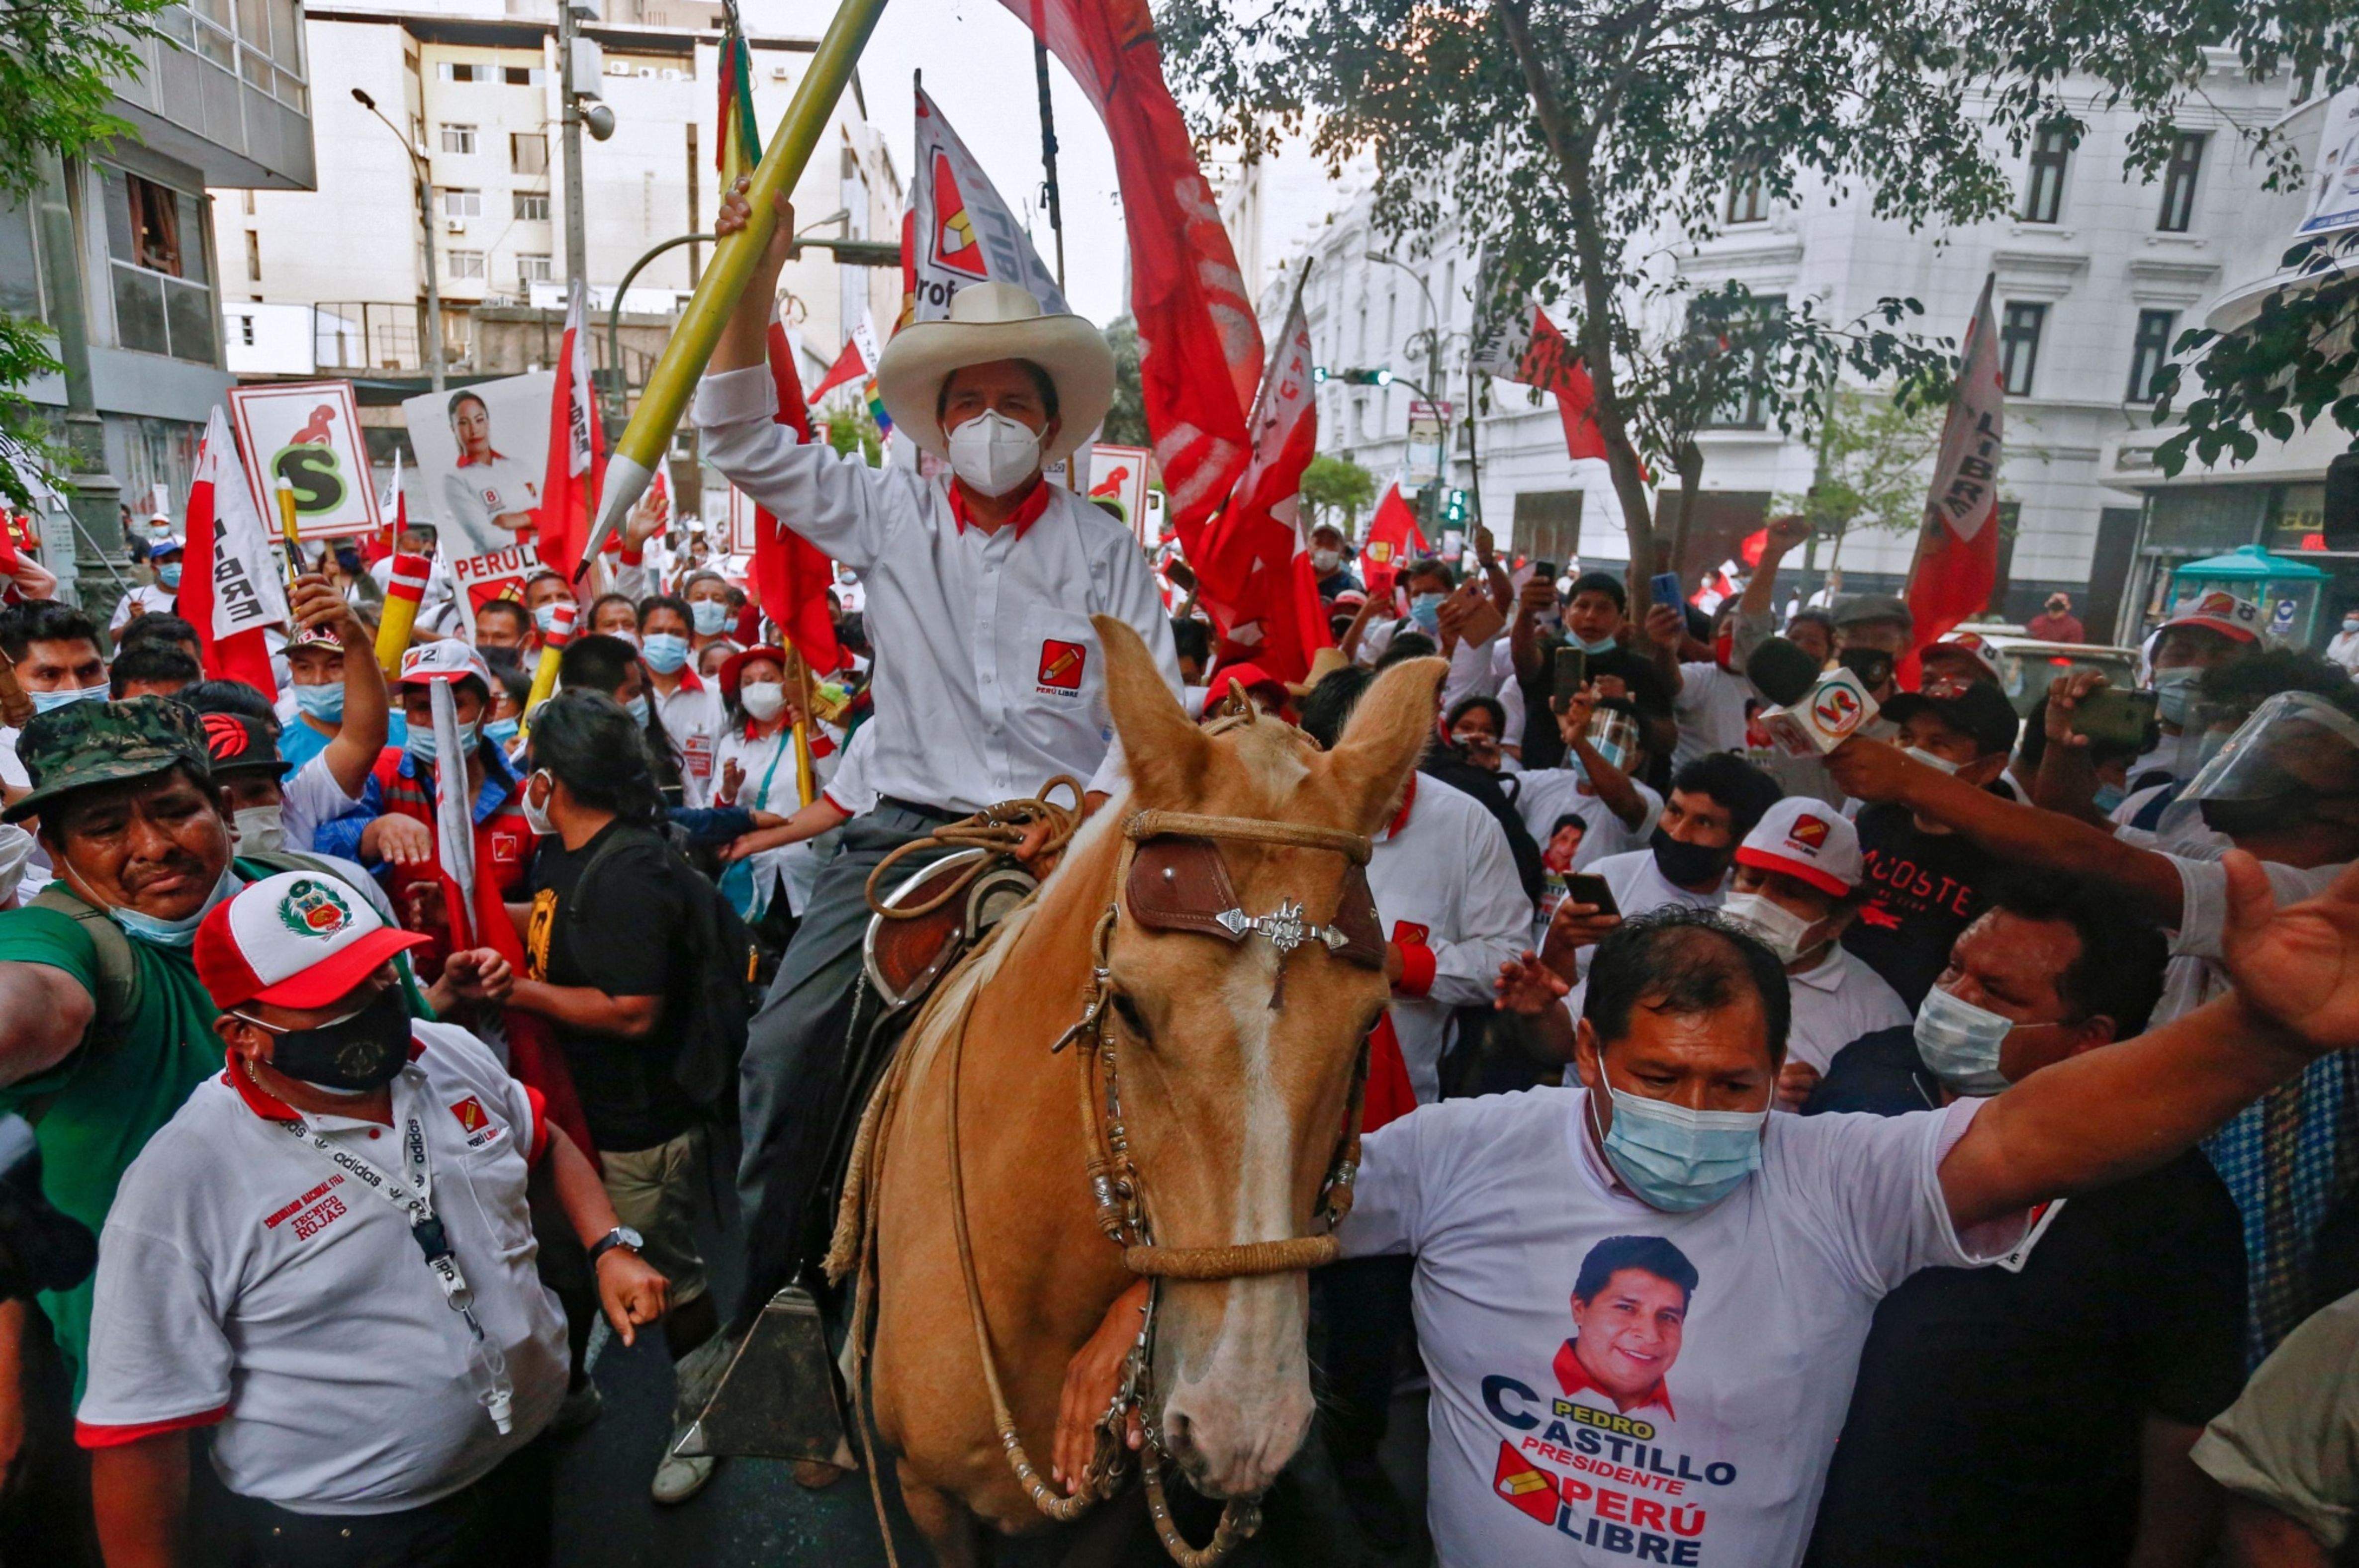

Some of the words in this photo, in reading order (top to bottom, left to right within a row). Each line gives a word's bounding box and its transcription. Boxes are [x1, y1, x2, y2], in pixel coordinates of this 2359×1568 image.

[486, 490, 496, 502] 8
[2238, 602, 2256, 621] 8
[422, 650, 437, 661] 2
[1058, 689, 1079, 698] LIBRE
[408, 1119, 425, 1164] adidas
[334, 1152, 381, 1187] adidas
[291, 1195, 339, 1228] TECNICO
[295, 1201, 347, 1241] ROJAS
[1552, 1397, 1655, 1441] PEDRO
[1521, 1436, 1686, 1495] PRESIDENTE
[1561, 1476, 1706, 1537] PERÚ
[1556, 1505, 1702, 1567] LIBRE
